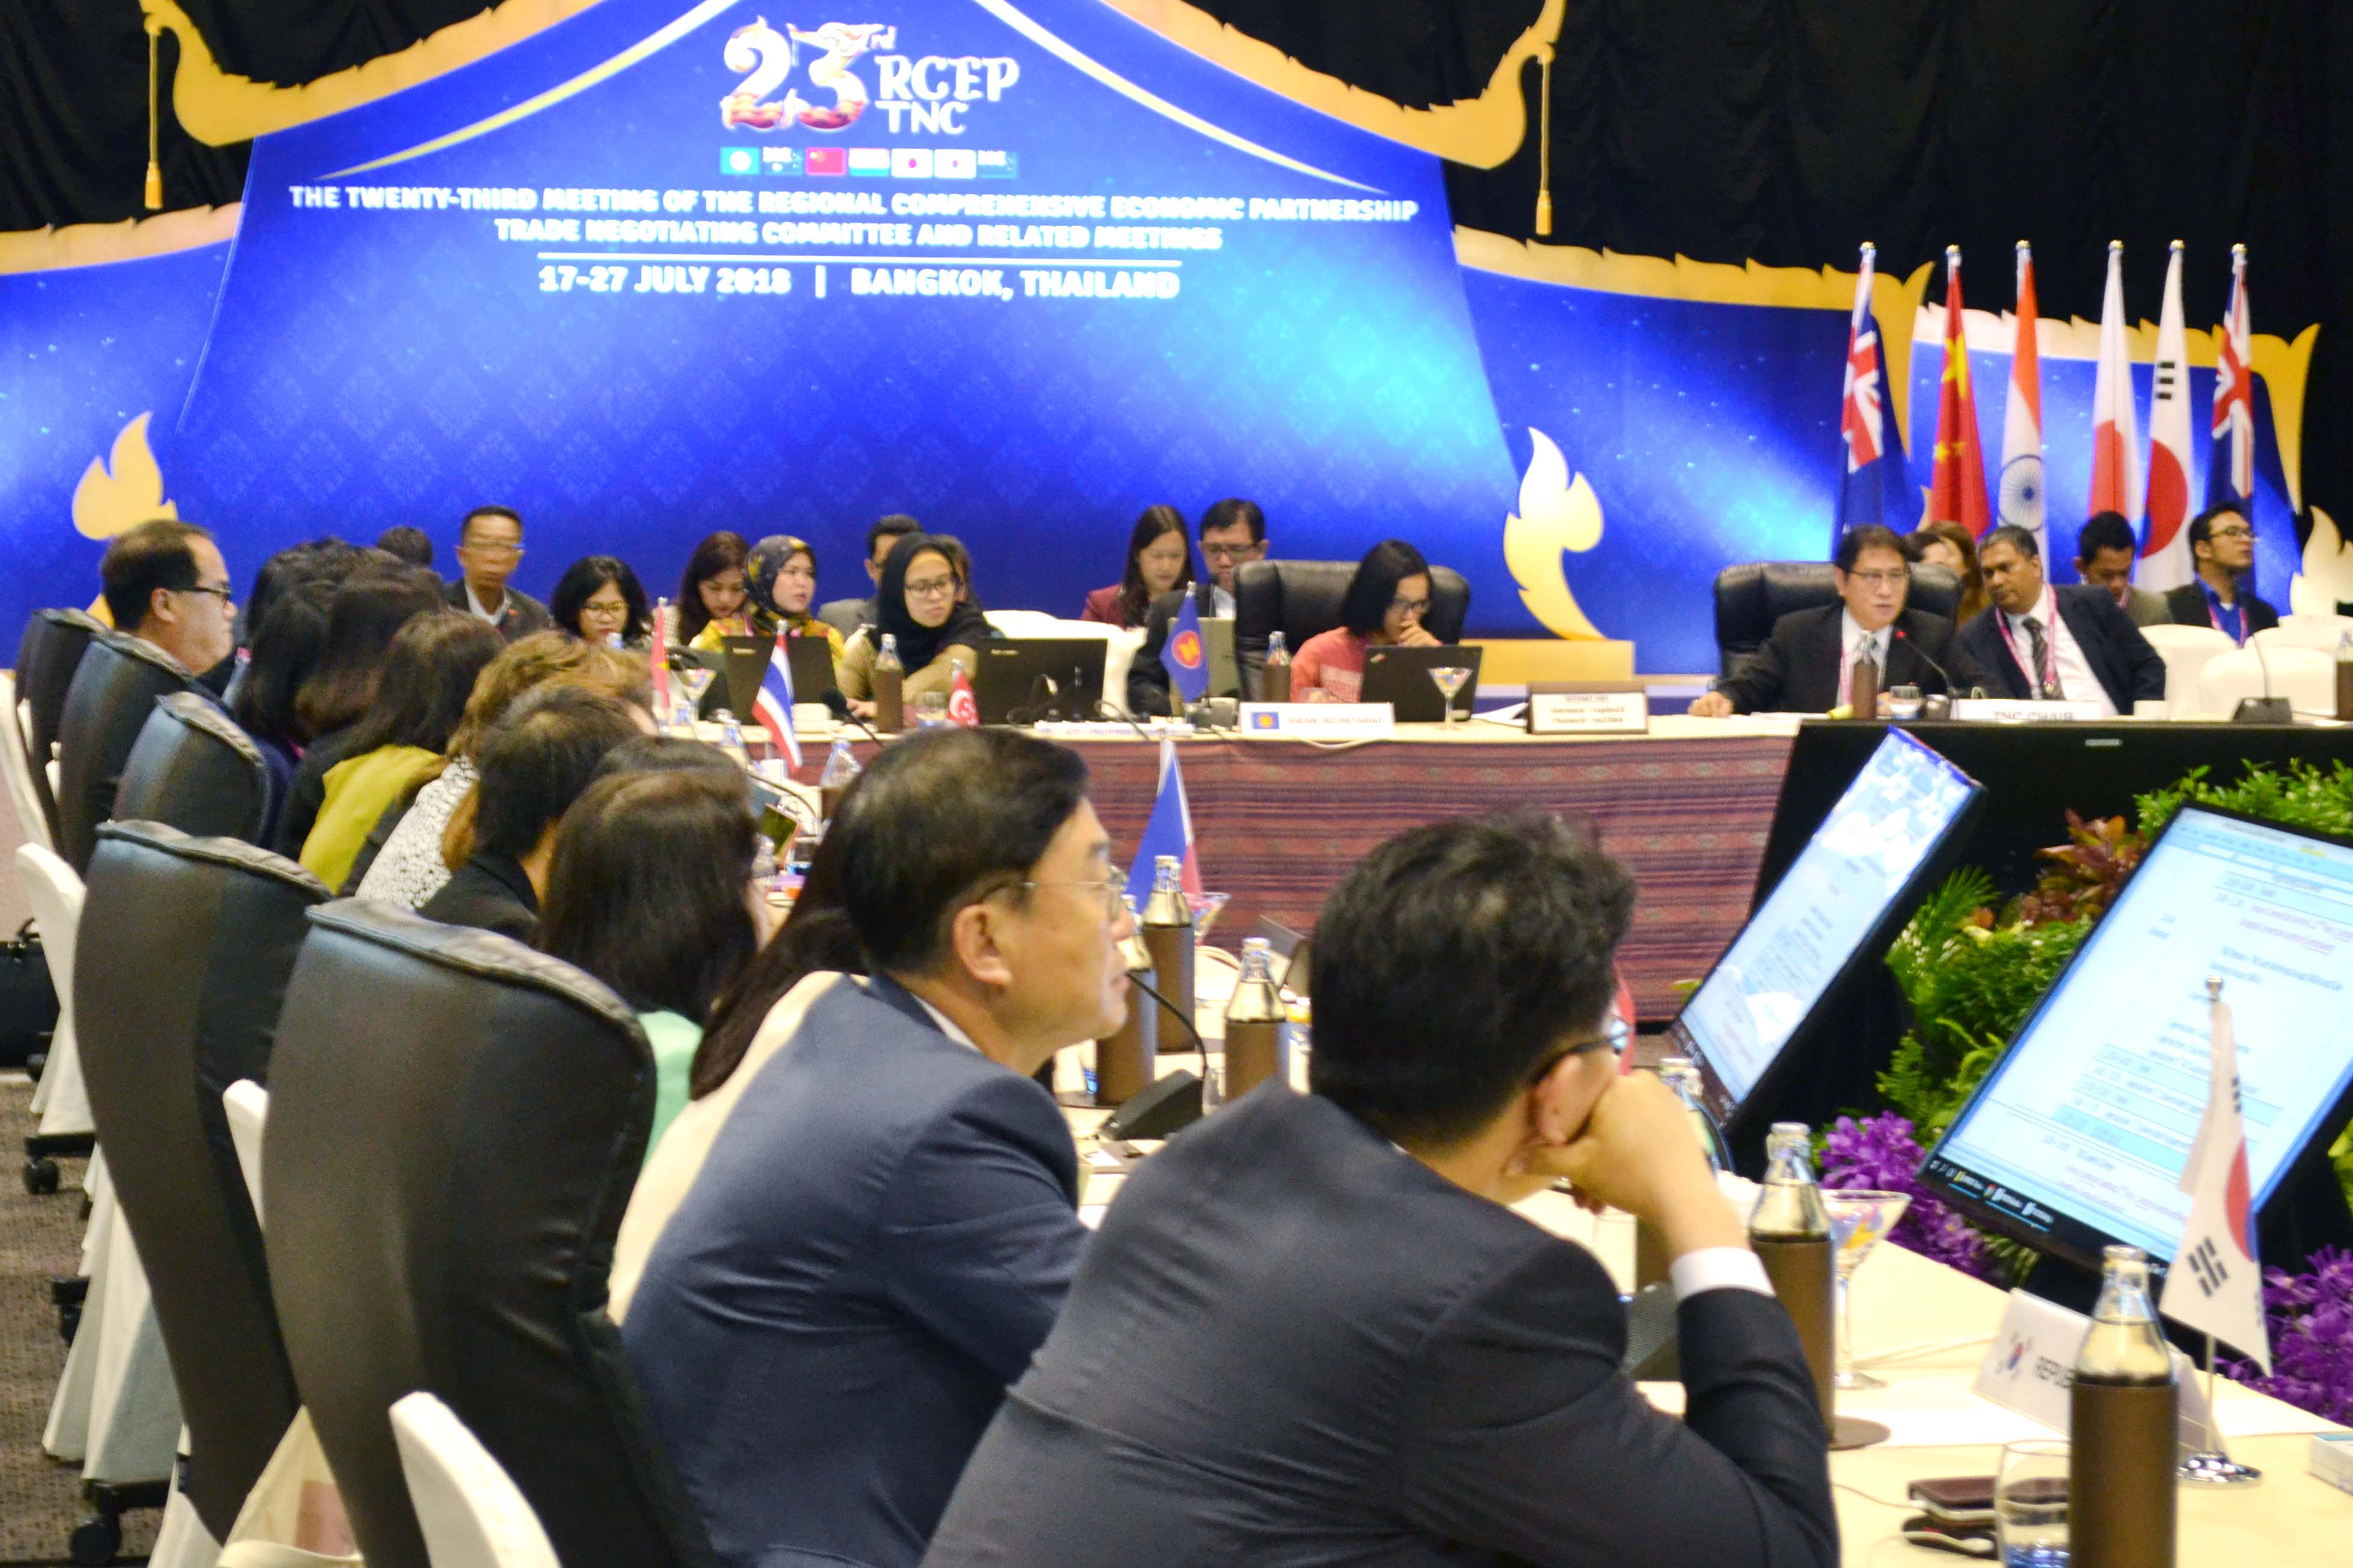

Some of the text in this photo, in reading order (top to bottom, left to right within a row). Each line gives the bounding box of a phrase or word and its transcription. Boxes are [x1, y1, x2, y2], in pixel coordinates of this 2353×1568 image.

[874, 55, 1019, 101] RCEP
[875, 101, 969, 134] TNC
[291, 186, 1418, 221] THE TWENTY-THIRD MEETING OF THE REGIONAL COMPREHENSIVE ECONOMIC PARTNERSHIP
[494, 218, 1223, 250] TRADE NEGOTIATING COMMITTEE AND RELATED MEETINGS
[538, 265, 1180, 300] 17-27 JULY 2018 BANGKOK, THAILAND
